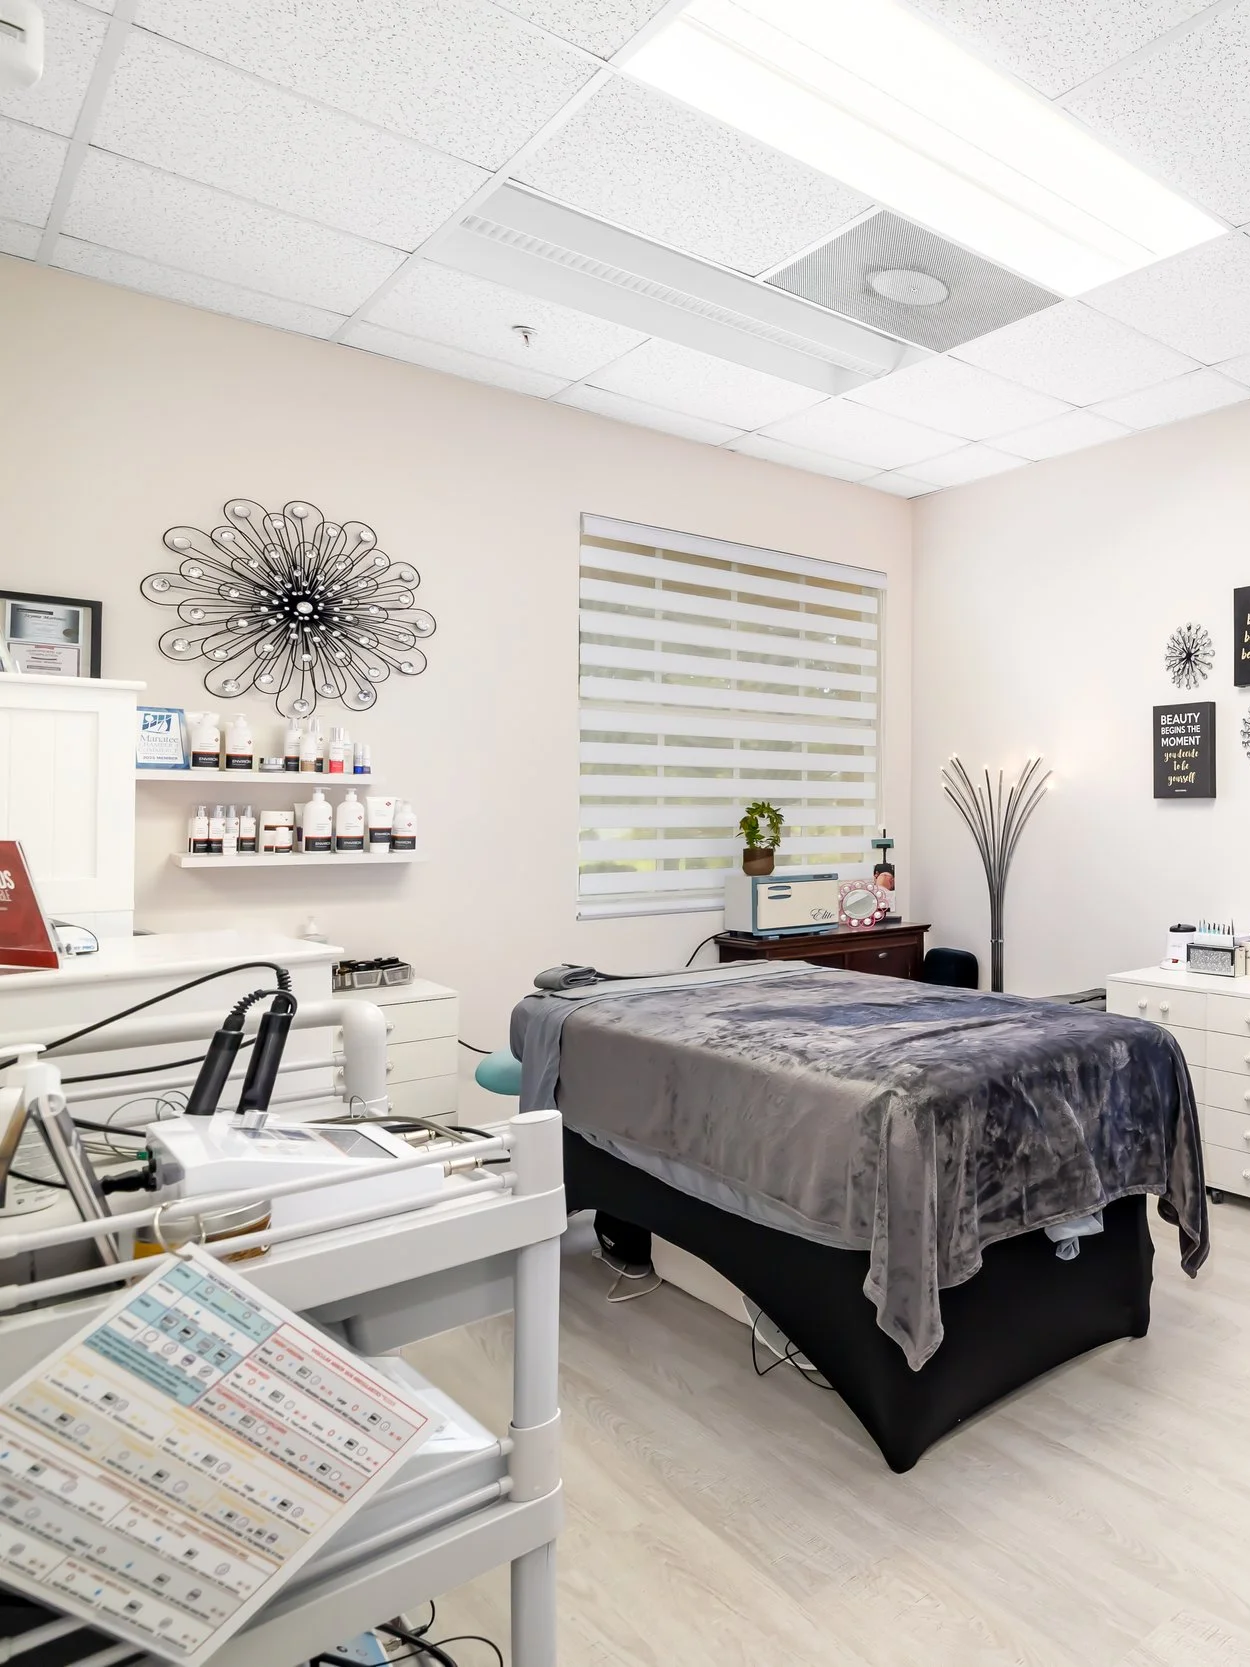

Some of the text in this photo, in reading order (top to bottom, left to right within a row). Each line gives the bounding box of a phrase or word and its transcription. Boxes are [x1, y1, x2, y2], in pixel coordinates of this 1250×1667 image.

[1160, 712, 1200, 725] BEAUTY
[1161, 726, 1186, 734] BEGINS
[140, 734, 179, 743] Manatee
[1162, 736, 1200, 747] MOMENT
[1164, 748, 1198, 762] you decide
[1168, 772, 1196, 786] yourself
[810, 908, 835, 921] Elite
